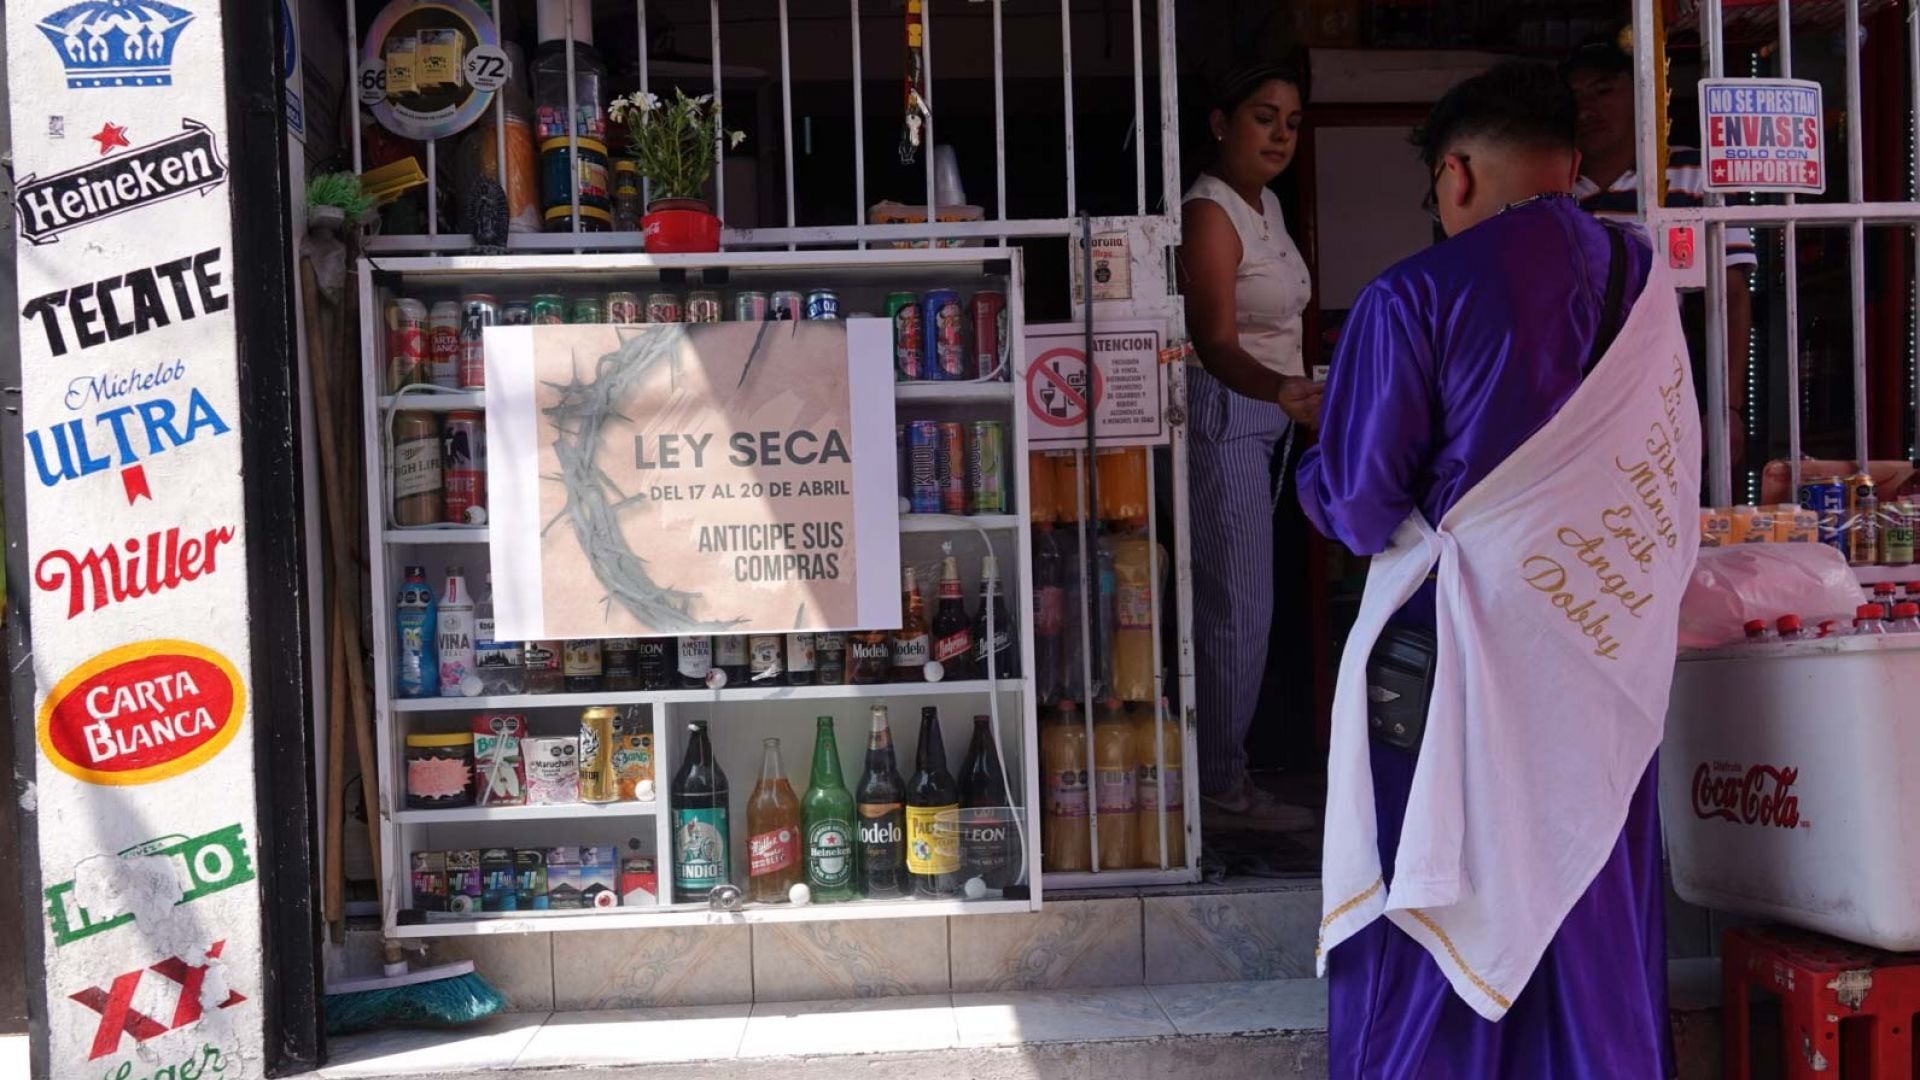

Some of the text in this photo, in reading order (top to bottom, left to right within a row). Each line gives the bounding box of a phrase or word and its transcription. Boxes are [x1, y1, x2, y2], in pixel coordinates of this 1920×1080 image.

[468, 55, 505, 78] $72
[1711, 89, 1817, 115] NO SE PRESTAN
[1710, 116, 1817, 149] ENVASES
[1725, 149, 1808, 159] SOLO CON
[1727, 160, 1807, 183] IMPORTE
[25, 145, 213, 232] Heineken
[22, 247, 230, 357] TECATE
[64, 358, 187, 411] Michelob
[25, 387, 232, 487] ULTRA
[634, 429, 852, 470] LEY SECA
[650, 480, 850, 501] DEL 17 AL 20 DE ABRIL
[1615, 455, 1677, 549] Mingo
[699, 521, 844, 552] ANTICIPE SUS
[1601, 504, 1655, 574] Erik
[35, 523, 235, 620] Miller
[734, 553, 839, 582] COMPRAS
[1556, 526, 1654, 618] Angel
[1522, 555, 1621, 660] Dobby
[86, 671, 200, 720] CARTA
[83, 707, 217, 763] BLANCA
[535, 759, 575, 769] Maruchan
[1692, 762, 1800, 829] Coca-Cola
[857, 821, 901, 844] odelo
[965, 827, 1006, 842] LEON
[811, 847, 851, 857] Heineken
[681, 863, 719, 879] INDIO
